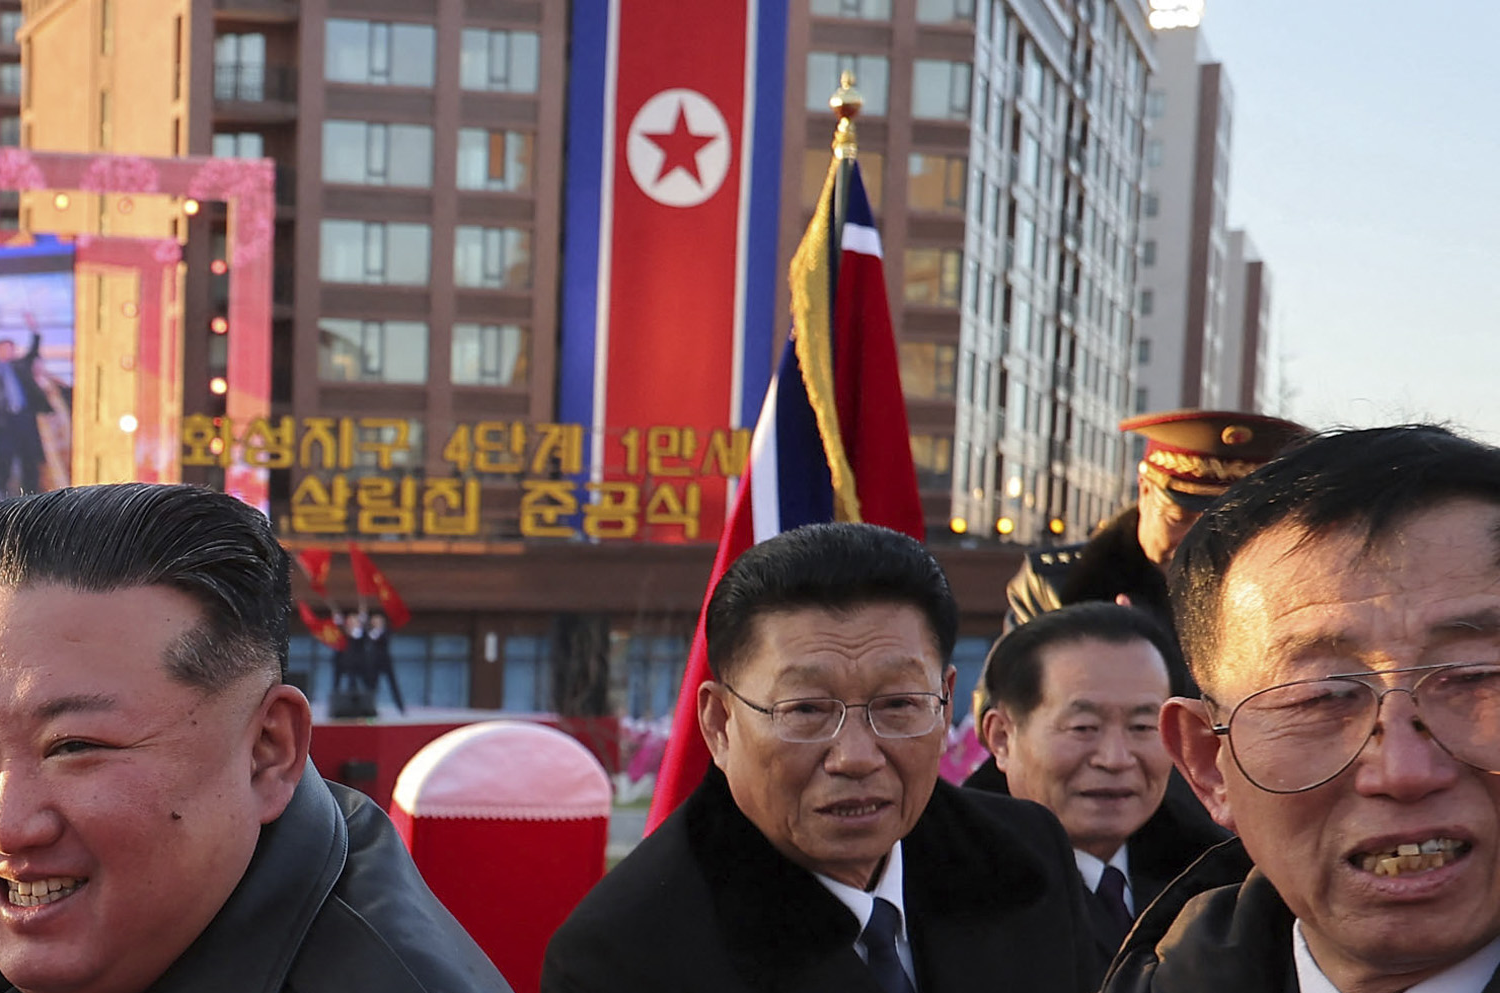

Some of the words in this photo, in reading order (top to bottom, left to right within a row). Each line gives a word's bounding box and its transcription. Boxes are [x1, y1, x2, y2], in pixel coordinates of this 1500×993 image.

[181, 413, 411, 470] 화성지구
[443, 420, 583, 474] 4단계
[291, 474, 480, 536] 살림집
[520, 479, 701, 539] 준공식
